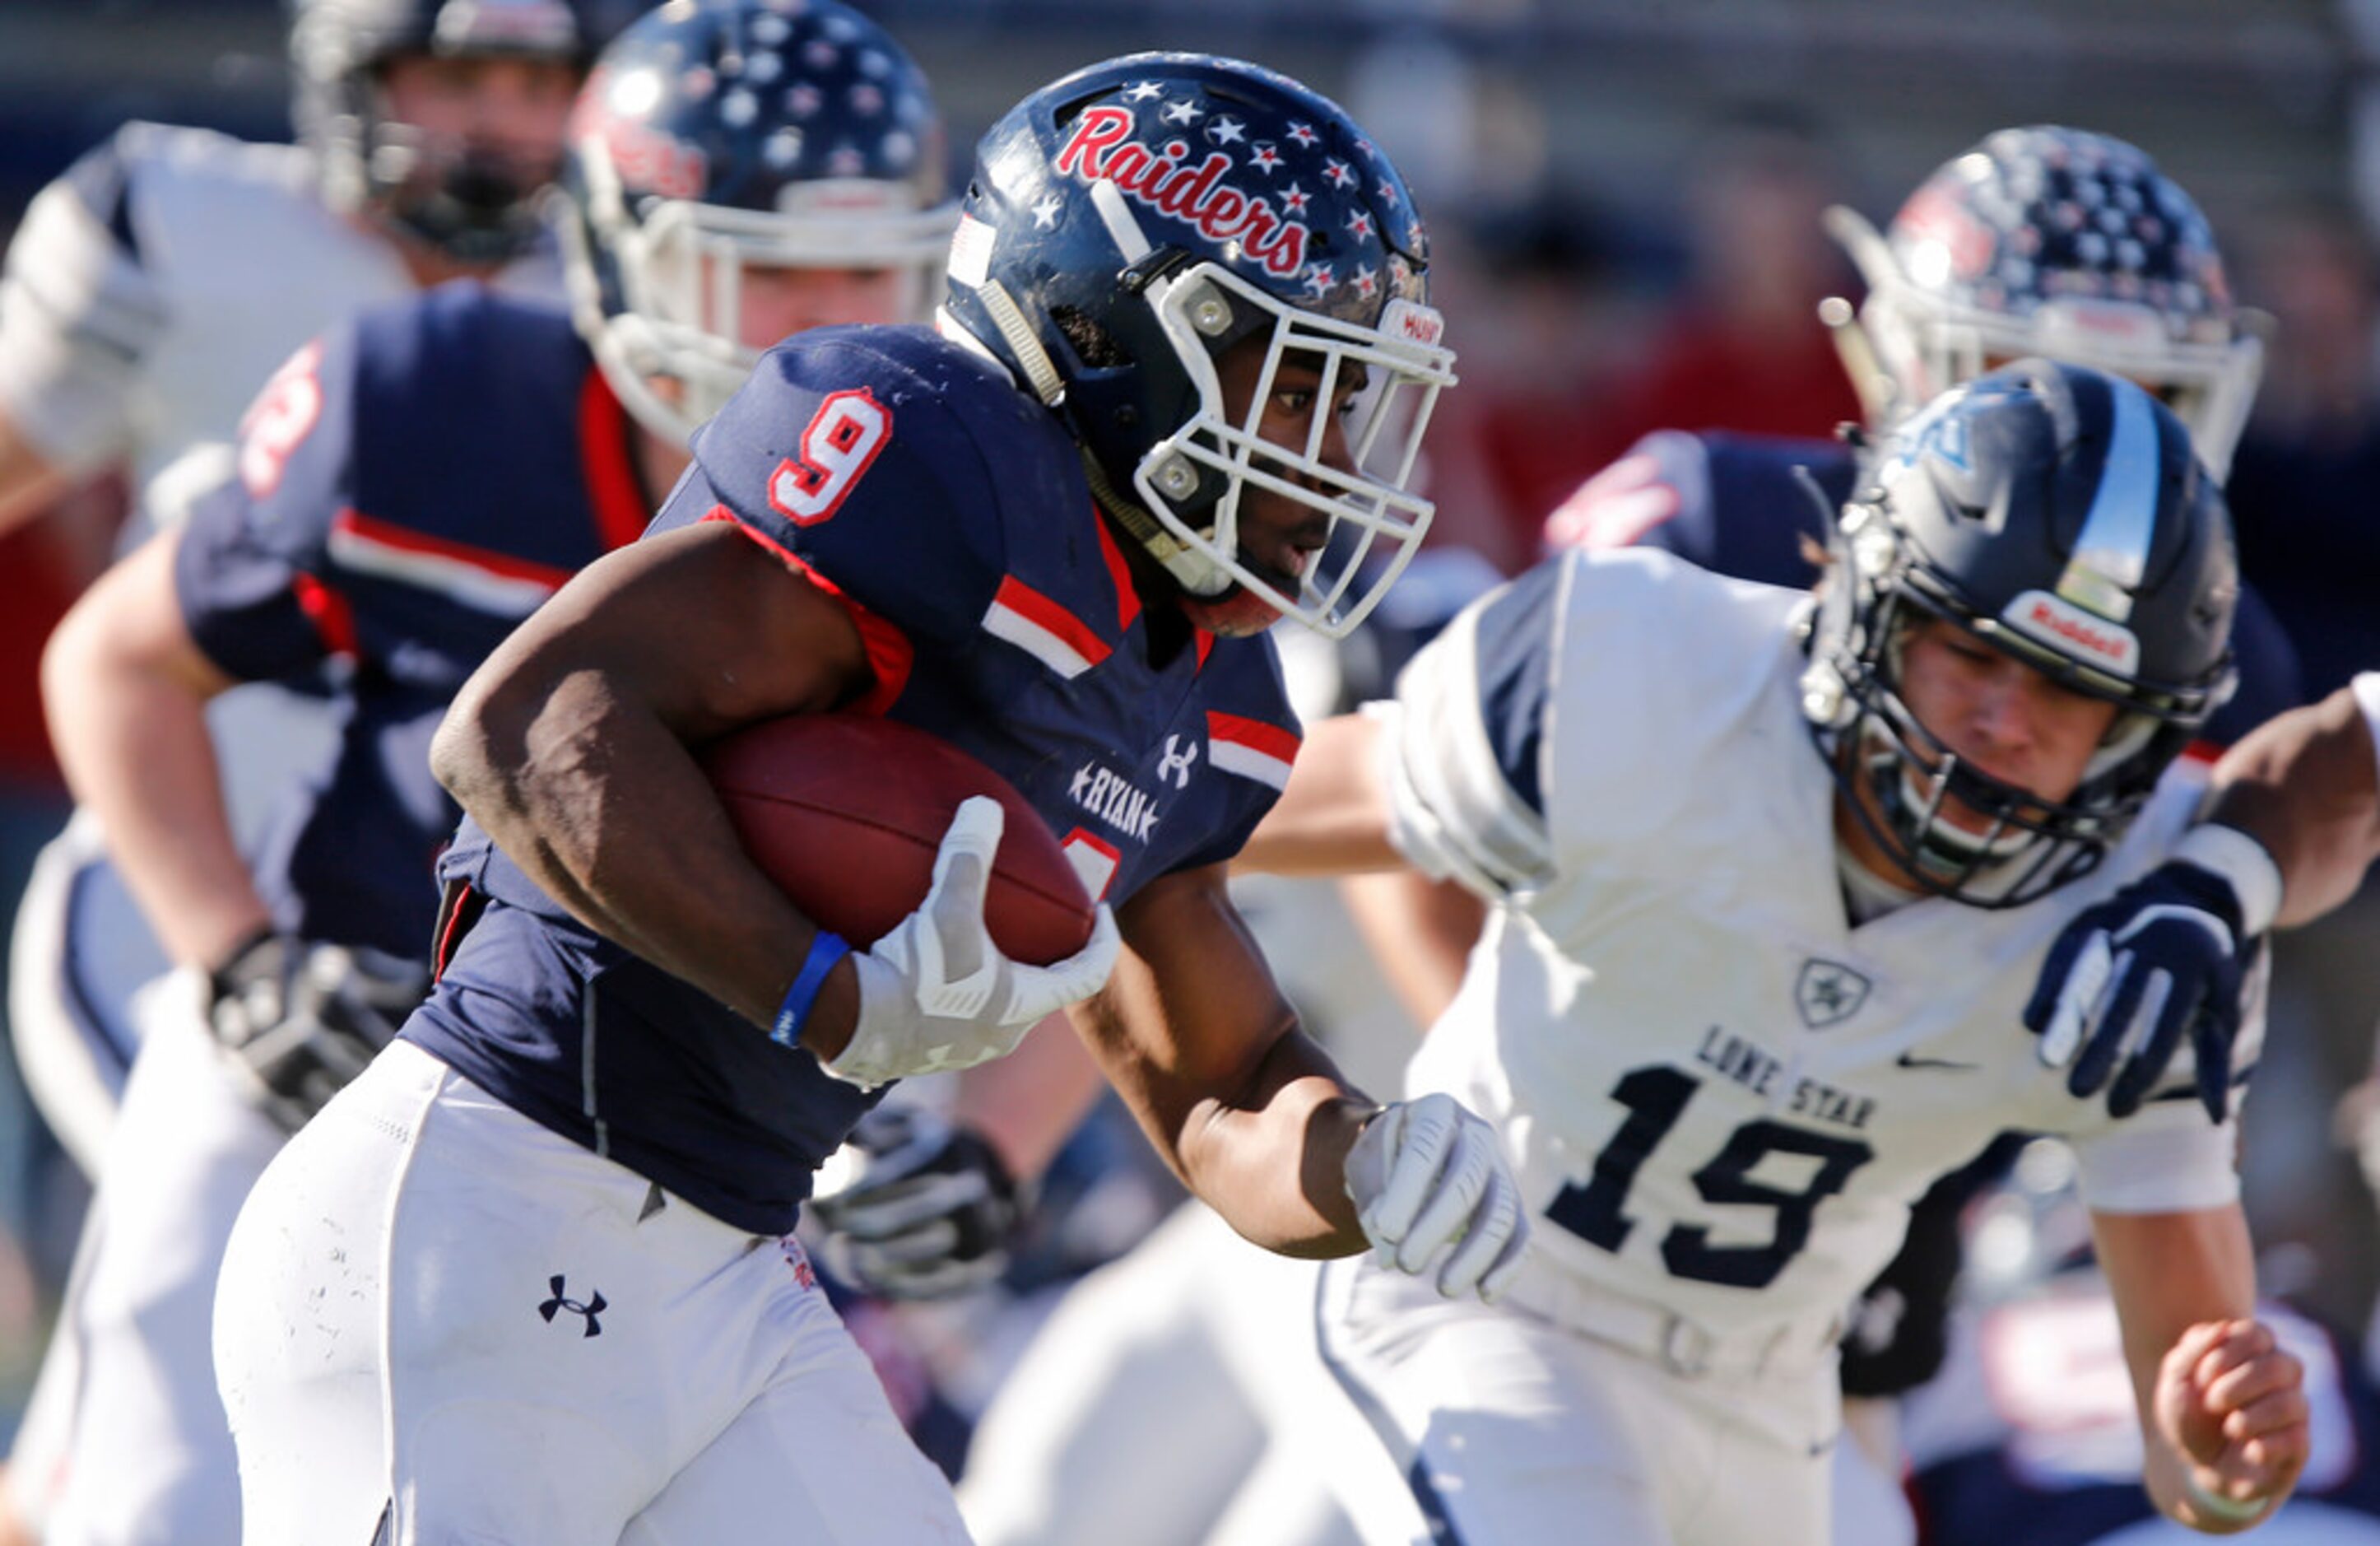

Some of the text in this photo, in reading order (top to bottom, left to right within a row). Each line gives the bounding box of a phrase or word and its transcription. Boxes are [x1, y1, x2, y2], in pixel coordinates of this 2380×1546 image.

[1054, 105, 1309, 278] Raiders
[767, 387, 893, 528] 9
[1082, 766, 1147, 836] RYAN
[1695, 1026, 1877, 1128] LONE STAR
[1543, 1064, 1876, 1290] 19
